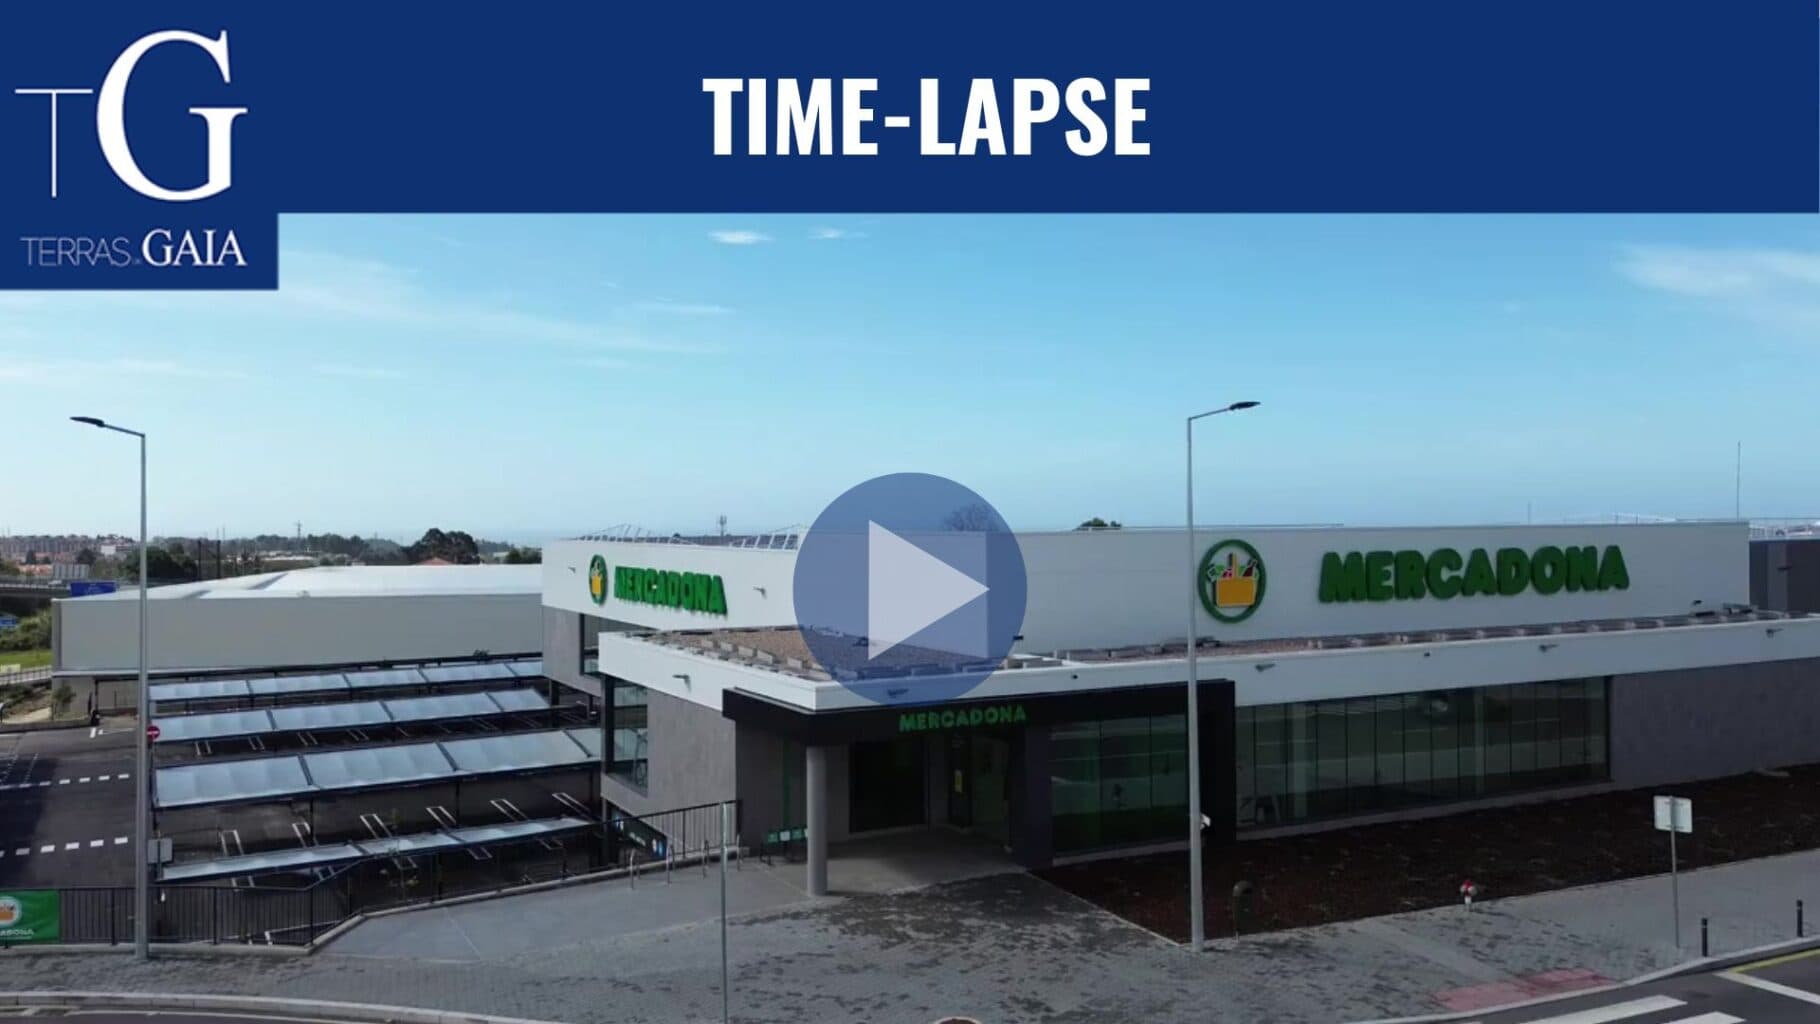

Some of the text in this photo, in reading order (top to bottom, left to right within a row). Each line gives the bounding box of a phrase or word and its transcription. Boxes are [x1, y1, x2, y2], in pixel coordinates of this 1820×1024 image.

[614, 566, 727, 615] MERCADONA
[1318, 545, 1630, 603] MERCADONA
[900, 705, 1026, 732] MERCADONA
